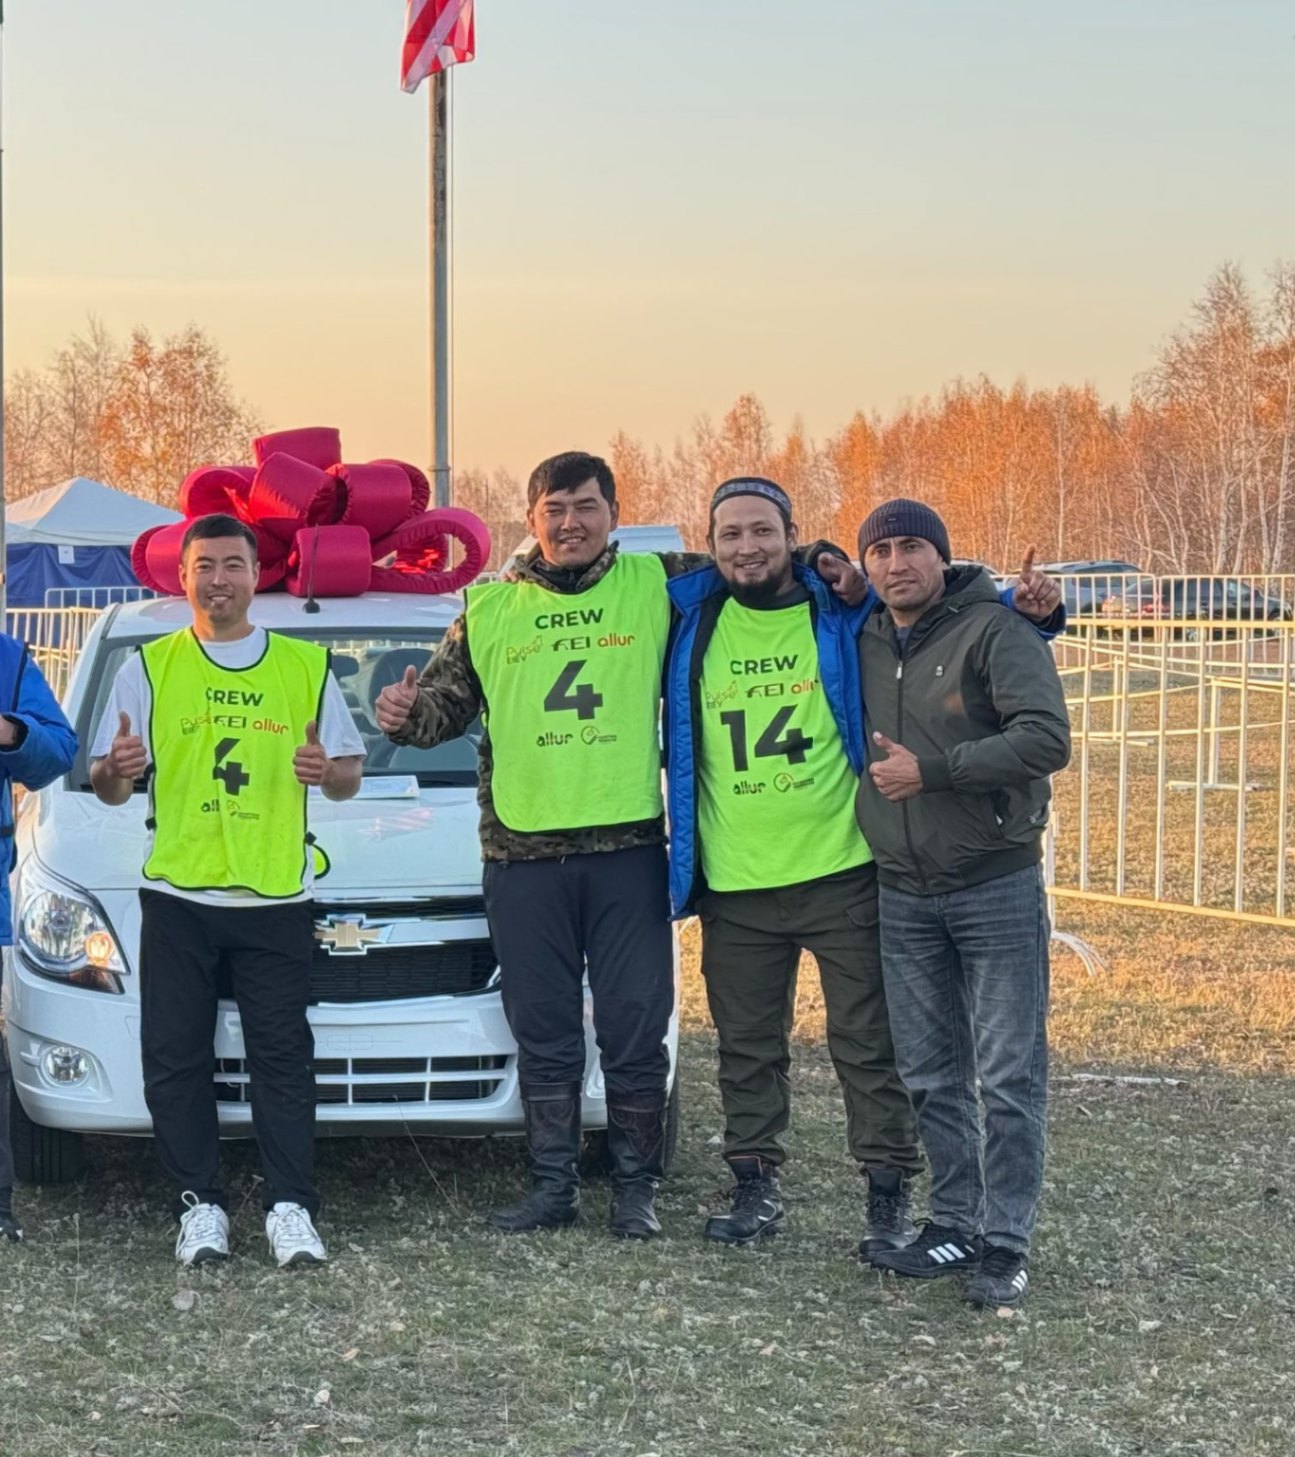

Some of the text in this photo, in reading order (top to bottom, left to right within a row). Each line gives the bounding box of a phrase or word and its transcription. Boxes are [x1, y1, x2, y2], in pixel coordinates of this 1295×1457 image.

[535, 608, 604, 630] CREW
[551, 636, 591, 652] FEI
[597, 633, 635, 648] allur
[730, 654, 798, 676] CREW
[206, 687, 264, 707] CREW
[543, 659, 604, 721] 4
[745, 683, 784, 698] FEI
[213, 715, 247, 729] FEI
[253, 718, 289, 735] allur
[536, 732, 573, 747] allur
[720, 704, 814, 772] 14
[212, 737, 250, 796] 4
[733, 780, 767, 796] allur
